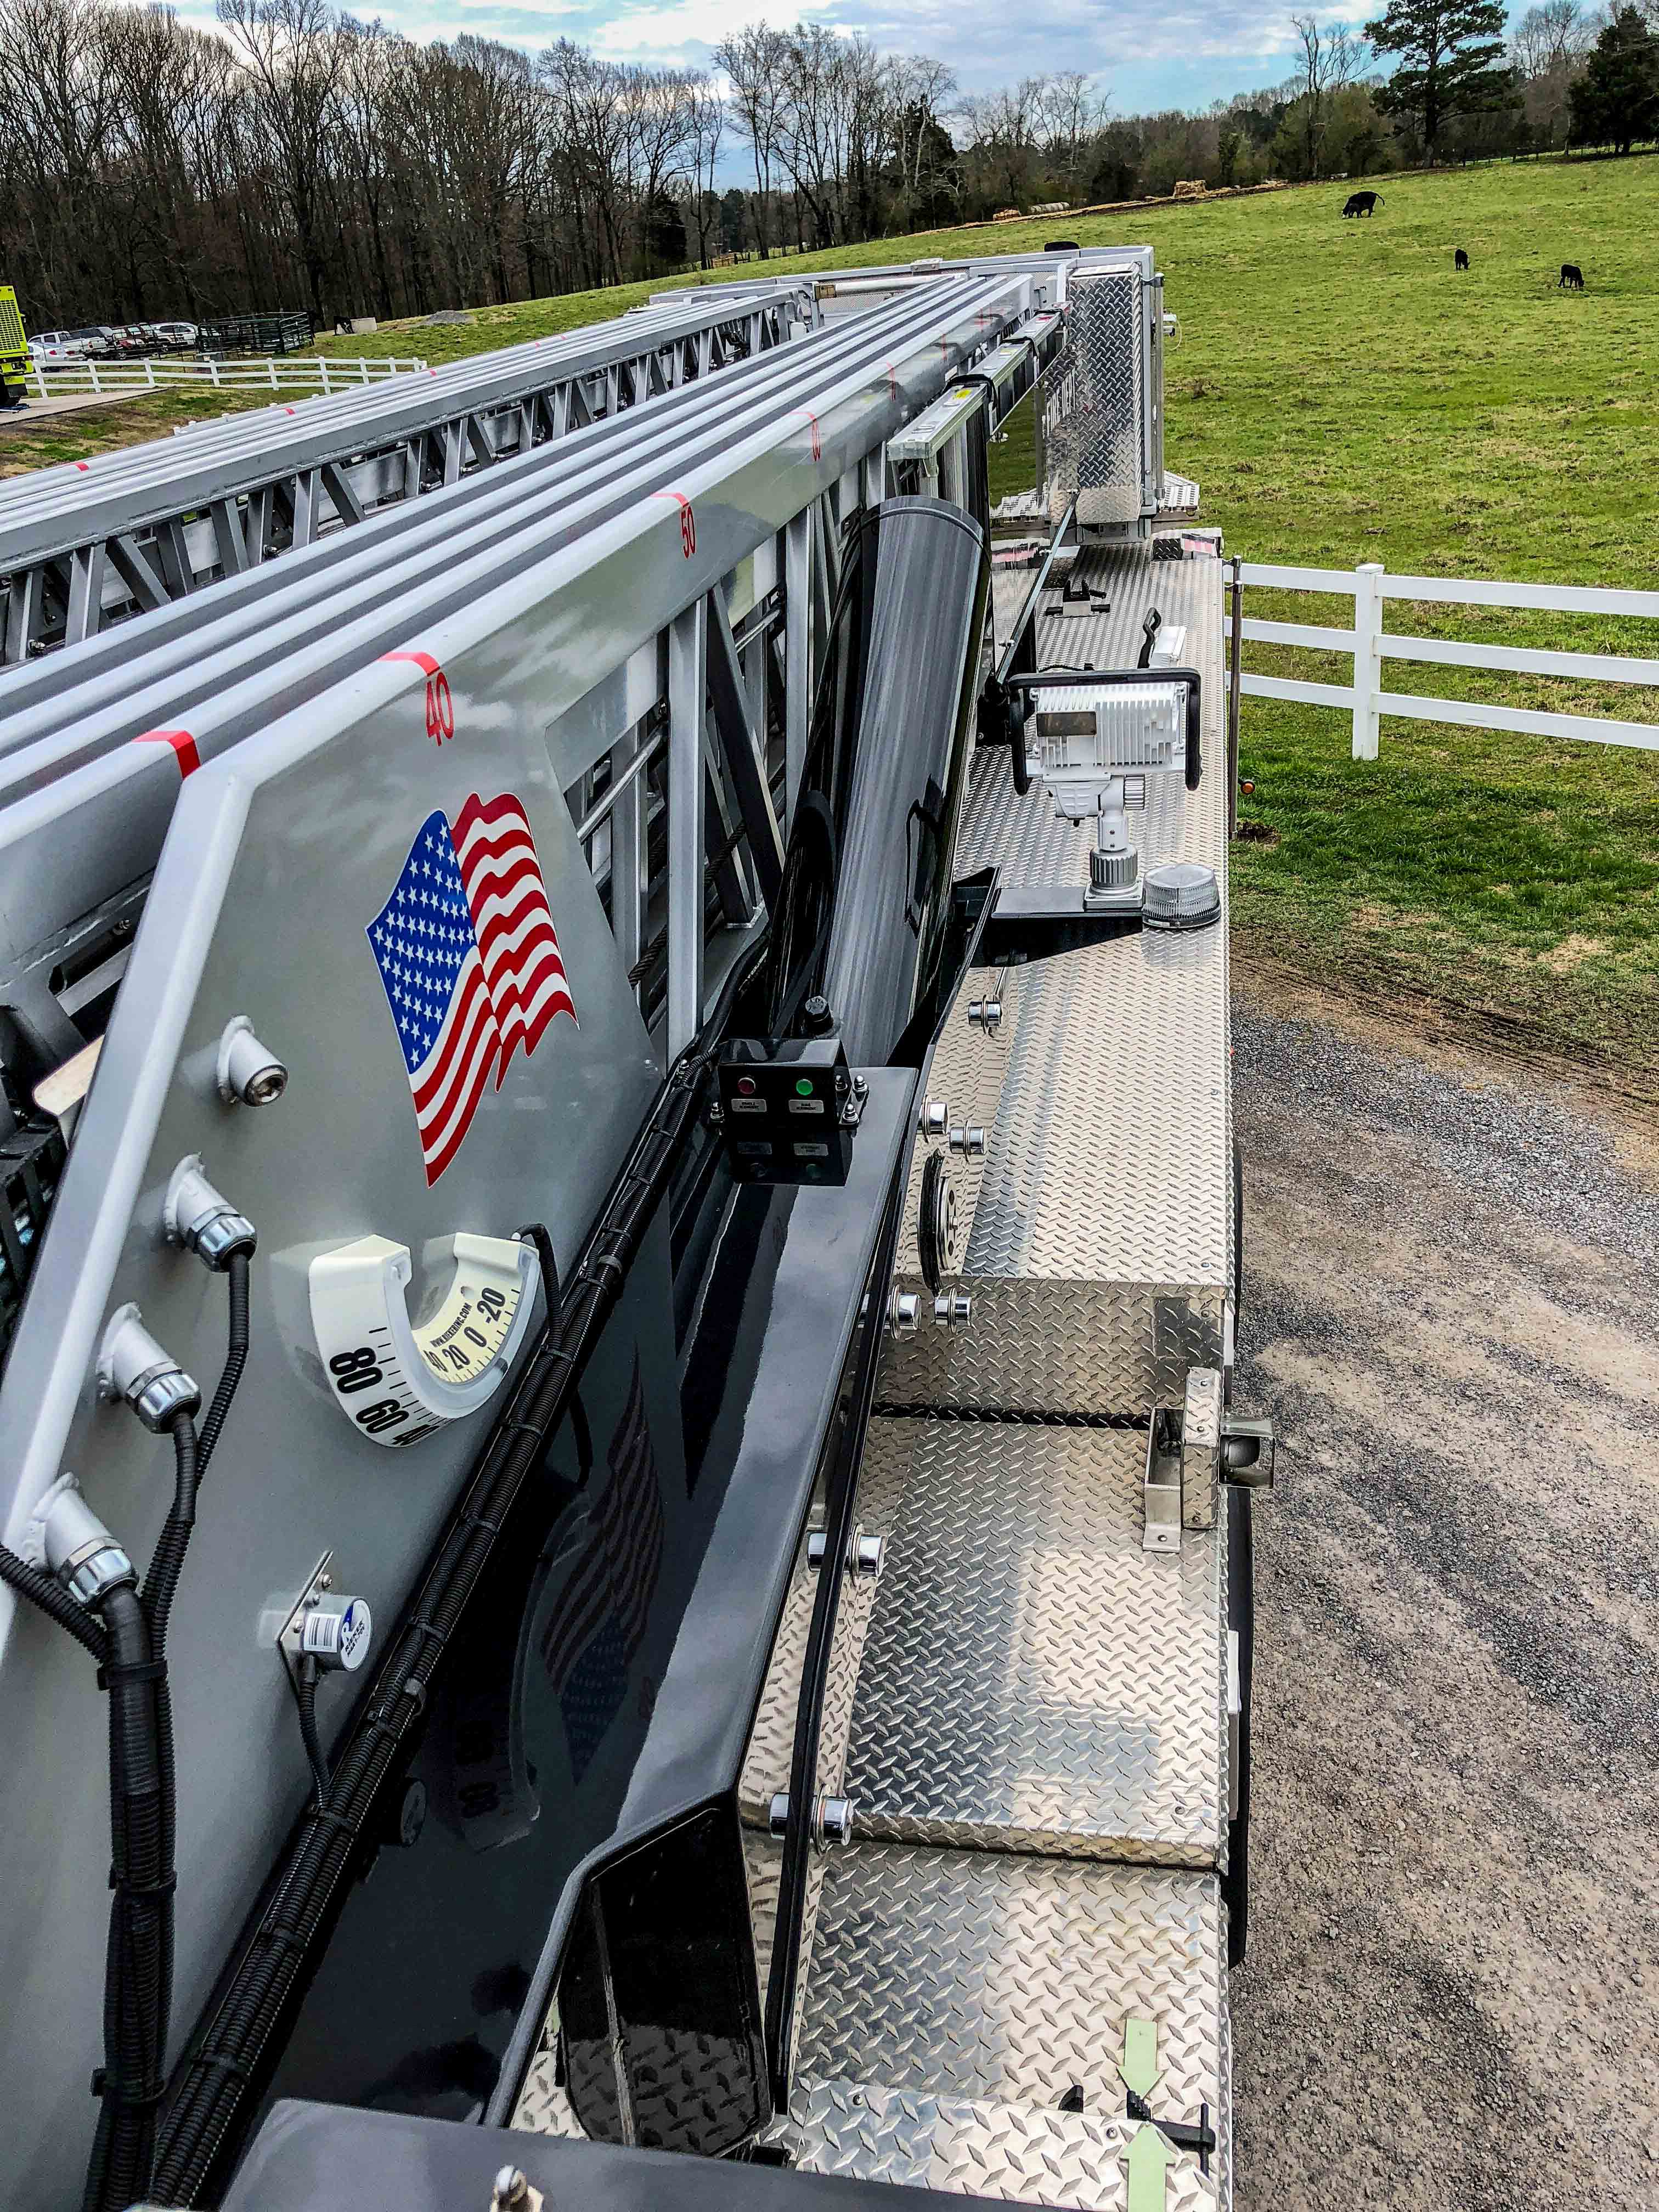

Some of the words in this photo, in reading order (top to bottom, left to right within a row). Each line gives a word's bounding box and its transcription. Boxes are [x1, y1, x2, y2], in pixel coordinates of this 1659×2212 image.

[681, 505, 696, 558] 50
[426, 672, 454, 747] 40
[477, 1288, 506, 1324] -20
[464, 1327, 487, 1347] 0
[329, 1347, 383, 1394] 80
[423, 1350, 448, 1372] 40
[442, 1345, 470, 1370] 20
[356, 1399, 409, 1435] 60
